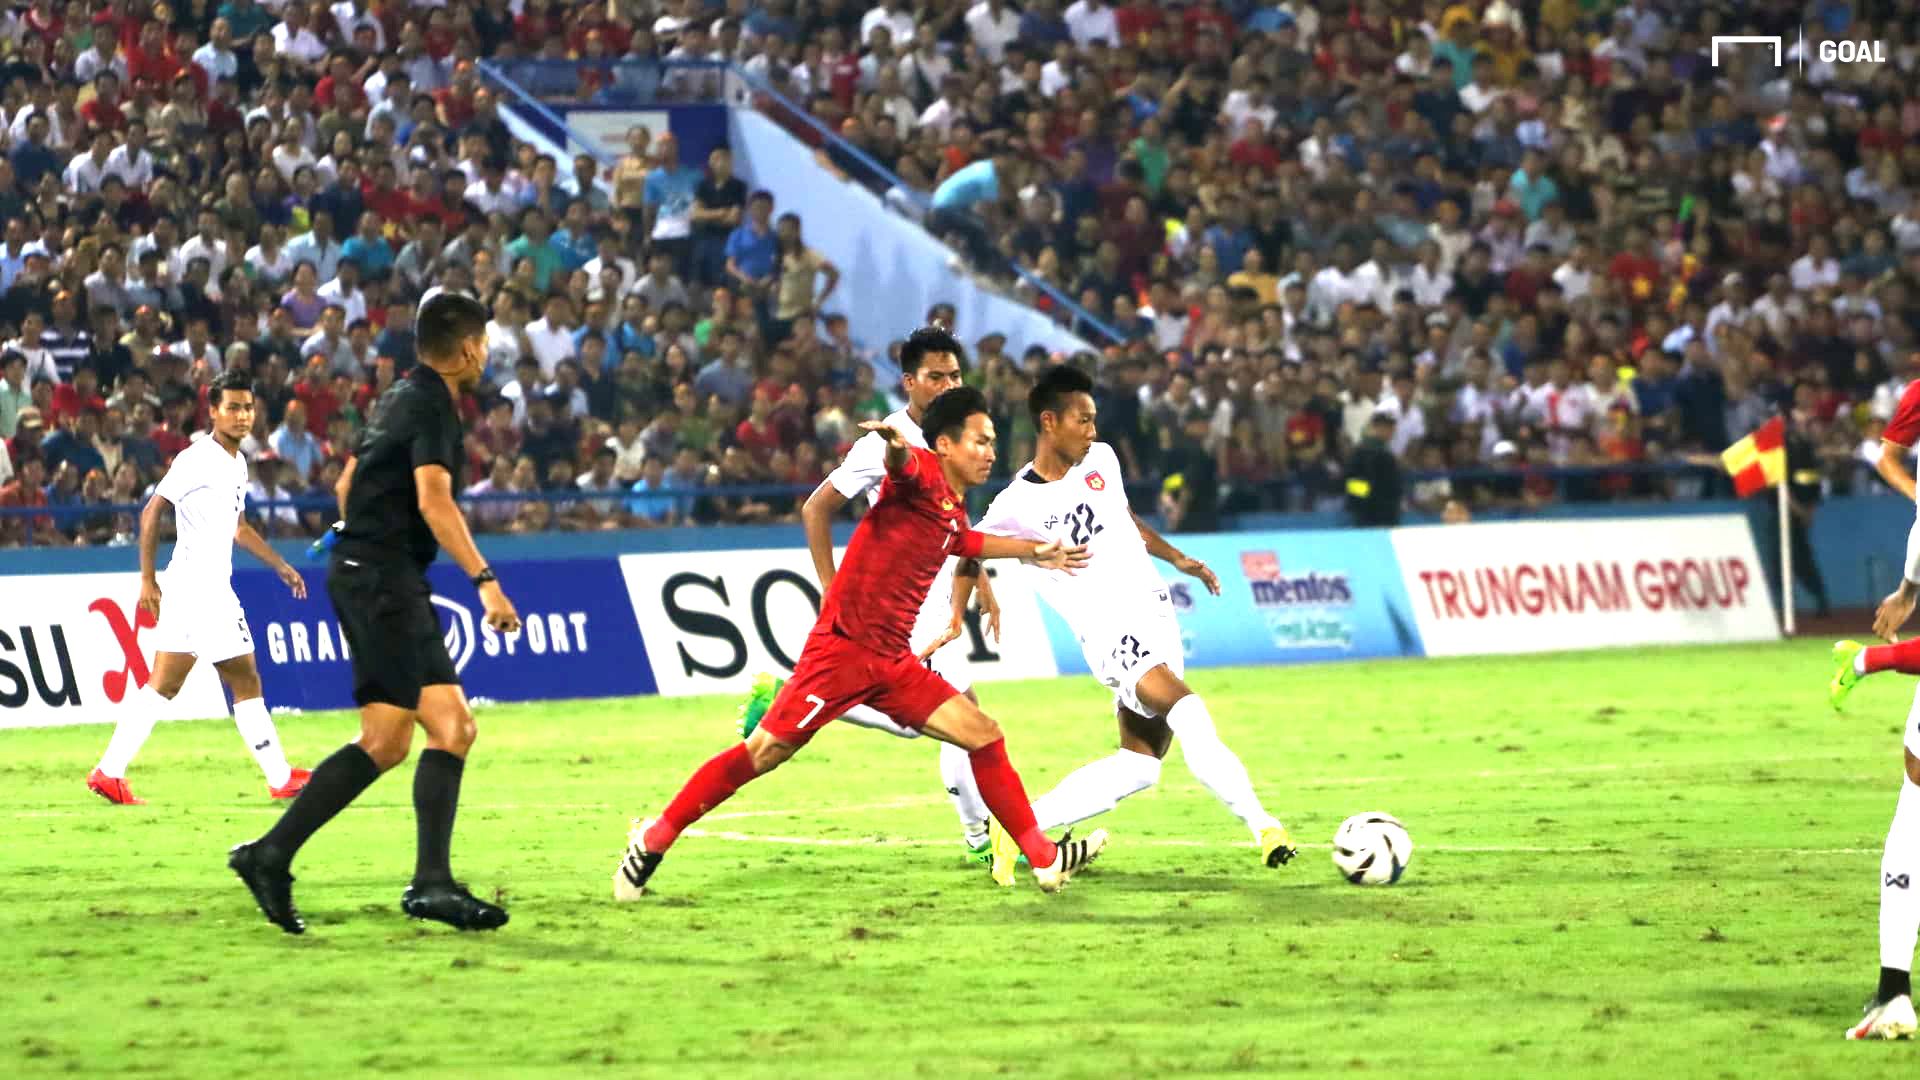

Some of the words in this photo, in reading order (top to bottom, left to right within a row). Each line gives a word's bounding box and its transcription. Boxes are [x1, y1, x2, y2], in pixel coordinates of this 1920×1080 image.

[1064, 503, 1105, 546] 22
[1251, 571, 1352, 603] mentos
[1419, 561, 1631, 619] TRUNGNAM
[1633, 556, 1750, 612] GROUP
[481, 612, 587, 656] SPORT
[797, 694, 824, 728] 7
